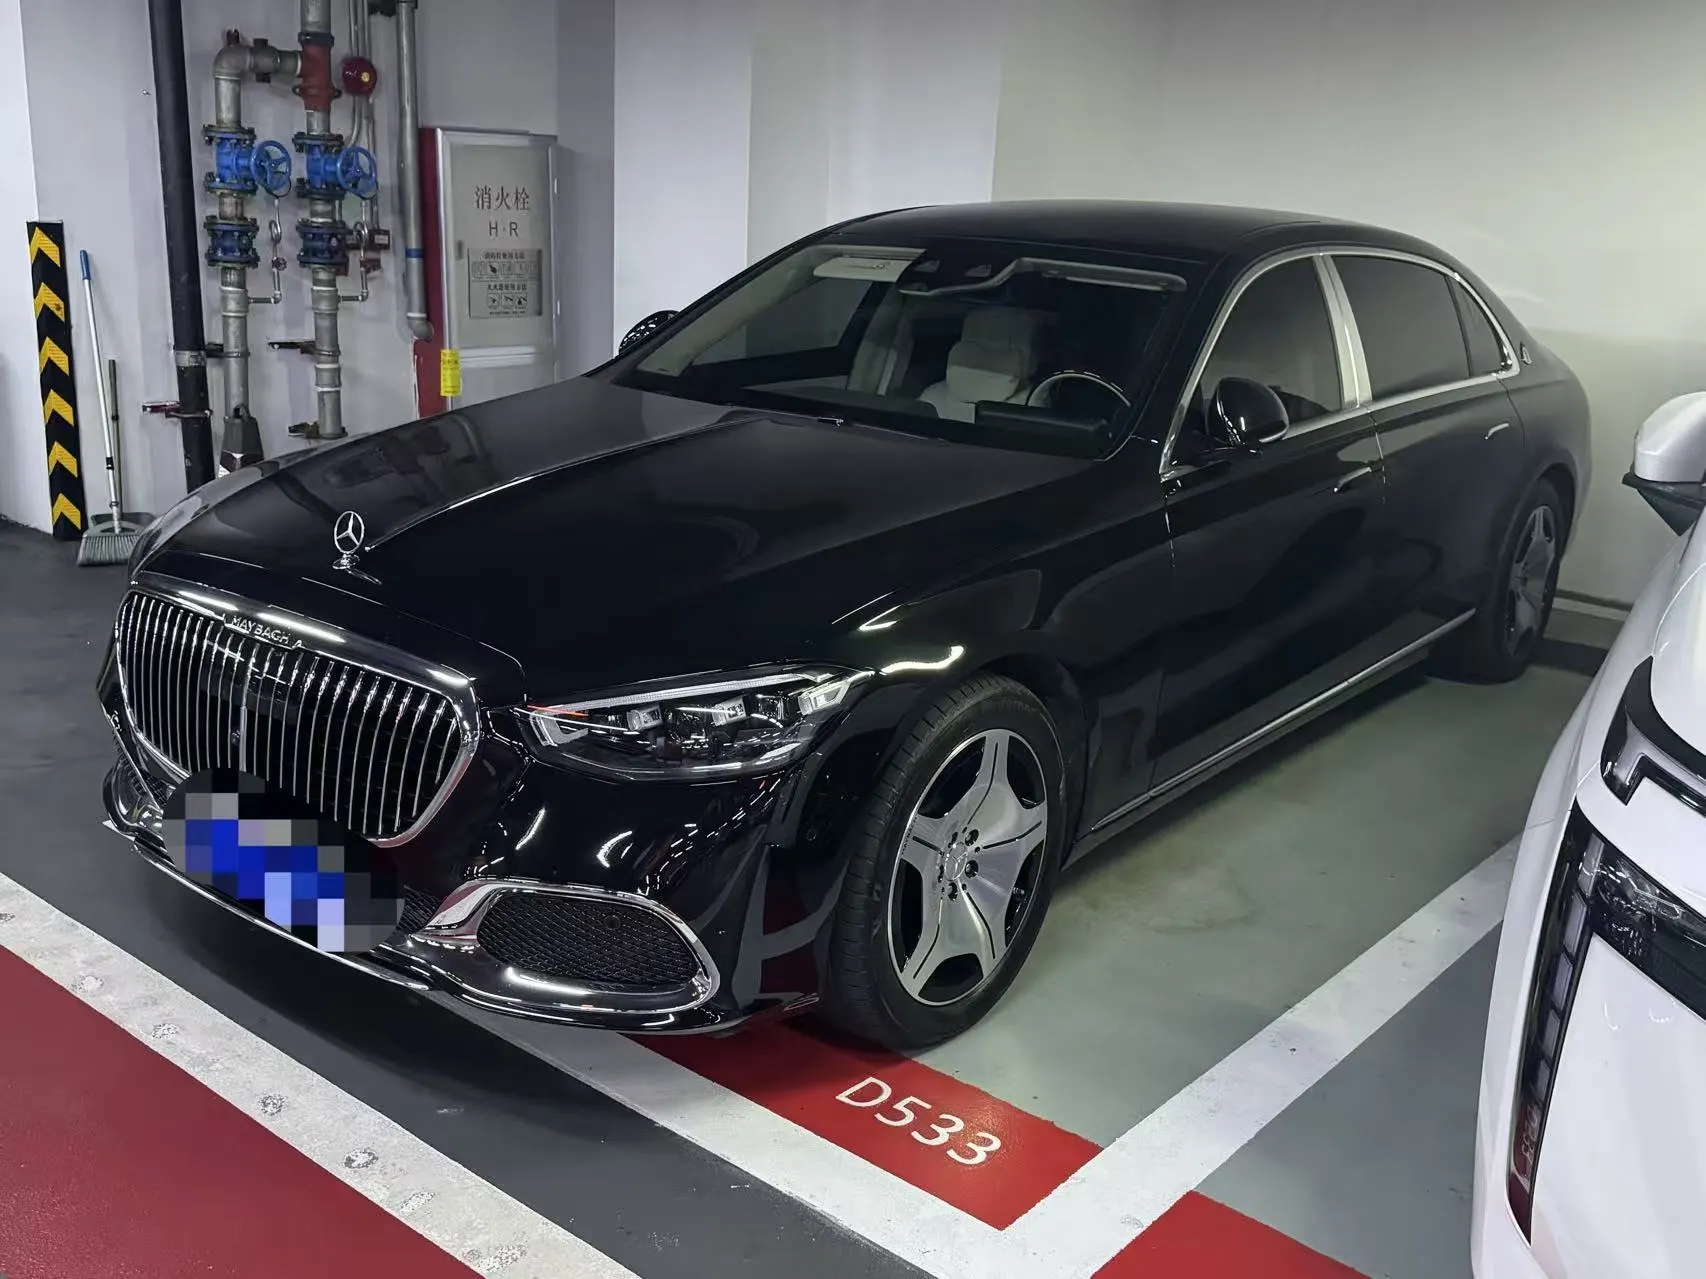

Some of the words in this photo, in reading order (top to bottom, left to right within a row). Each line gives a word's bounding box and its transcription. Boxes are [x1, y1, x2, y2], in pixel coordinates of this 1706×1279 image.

[474, 185, 530, 211] 消火栓
[835, 1076, 1002, 1165] D533
